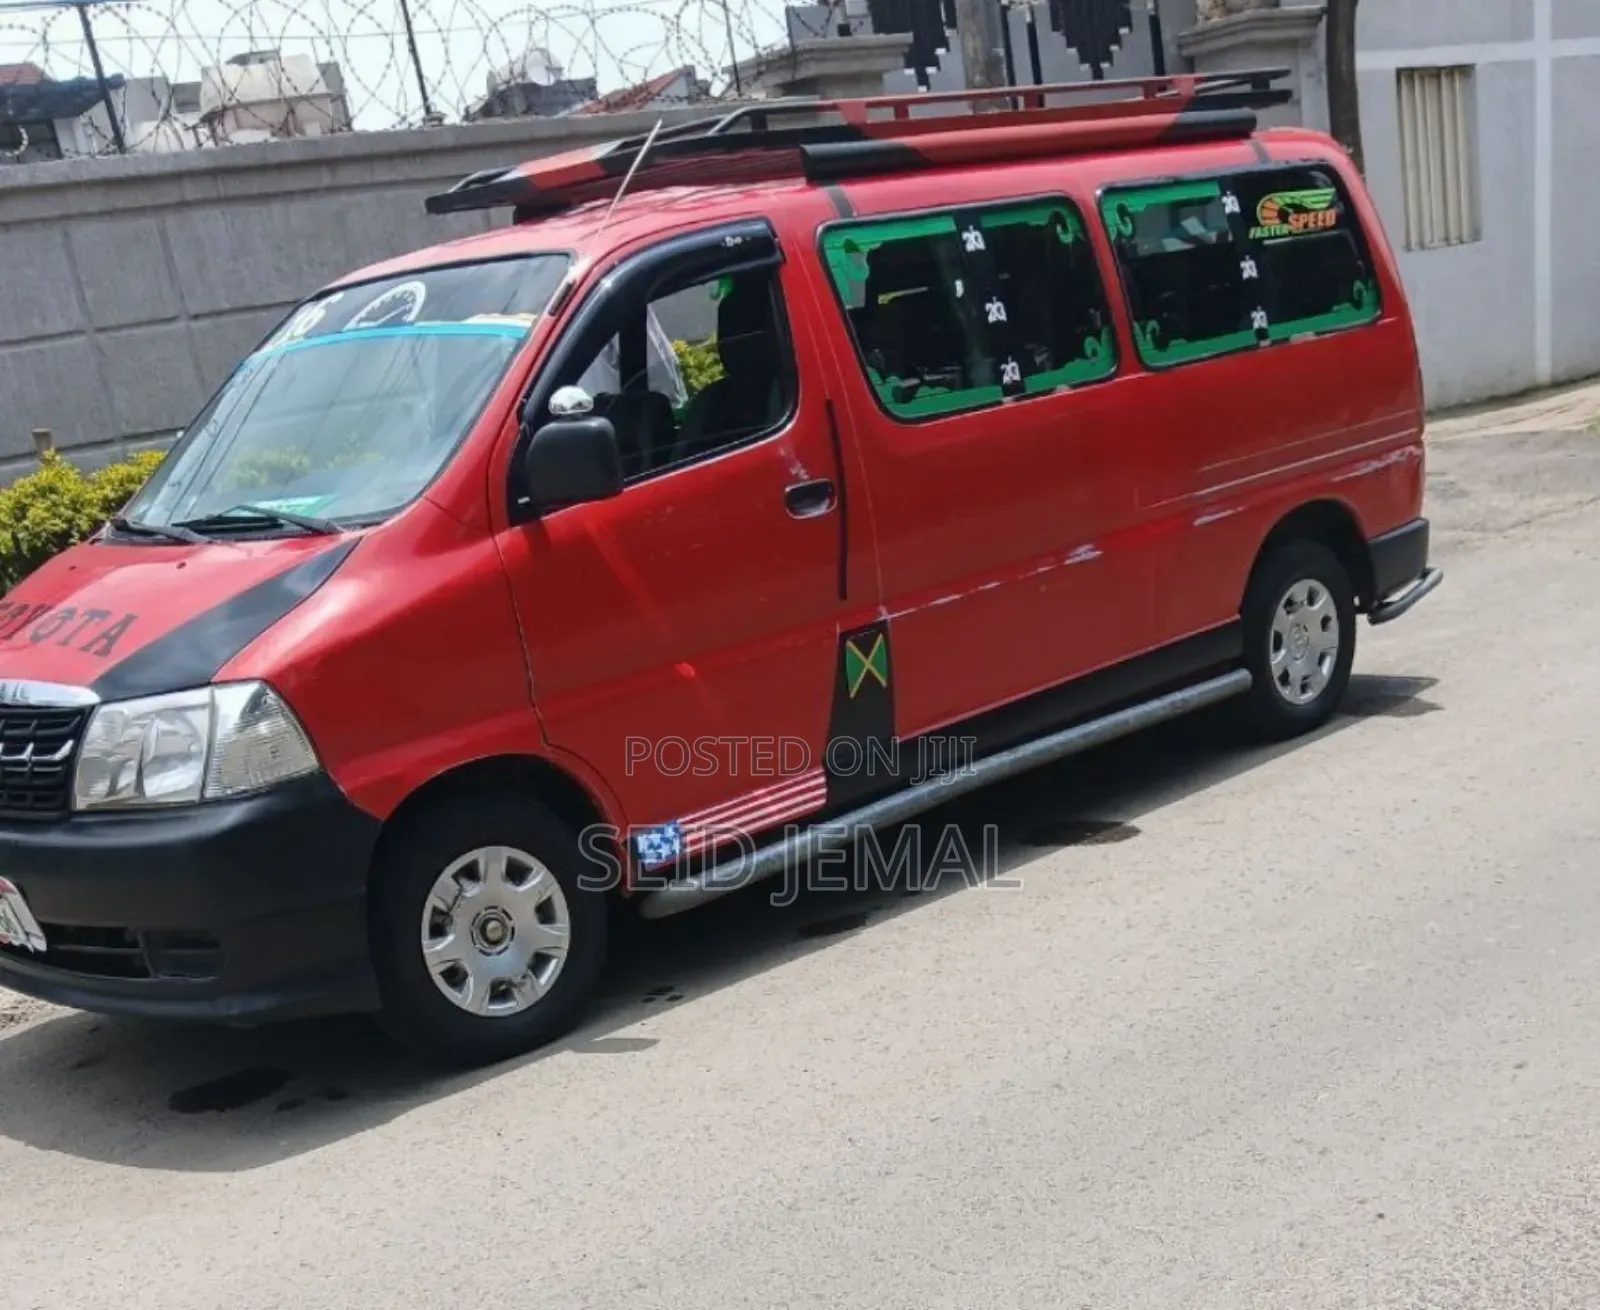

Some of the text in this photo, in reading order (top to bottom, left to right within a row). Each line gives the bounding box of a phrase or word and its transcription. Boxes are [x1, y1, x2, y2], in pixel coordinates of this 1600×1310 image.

[1249, 223, 1289, 239] FASTER
[1288, 209, 1337, 232] SPEED
[0, 602, 138, 658] OYOTA
